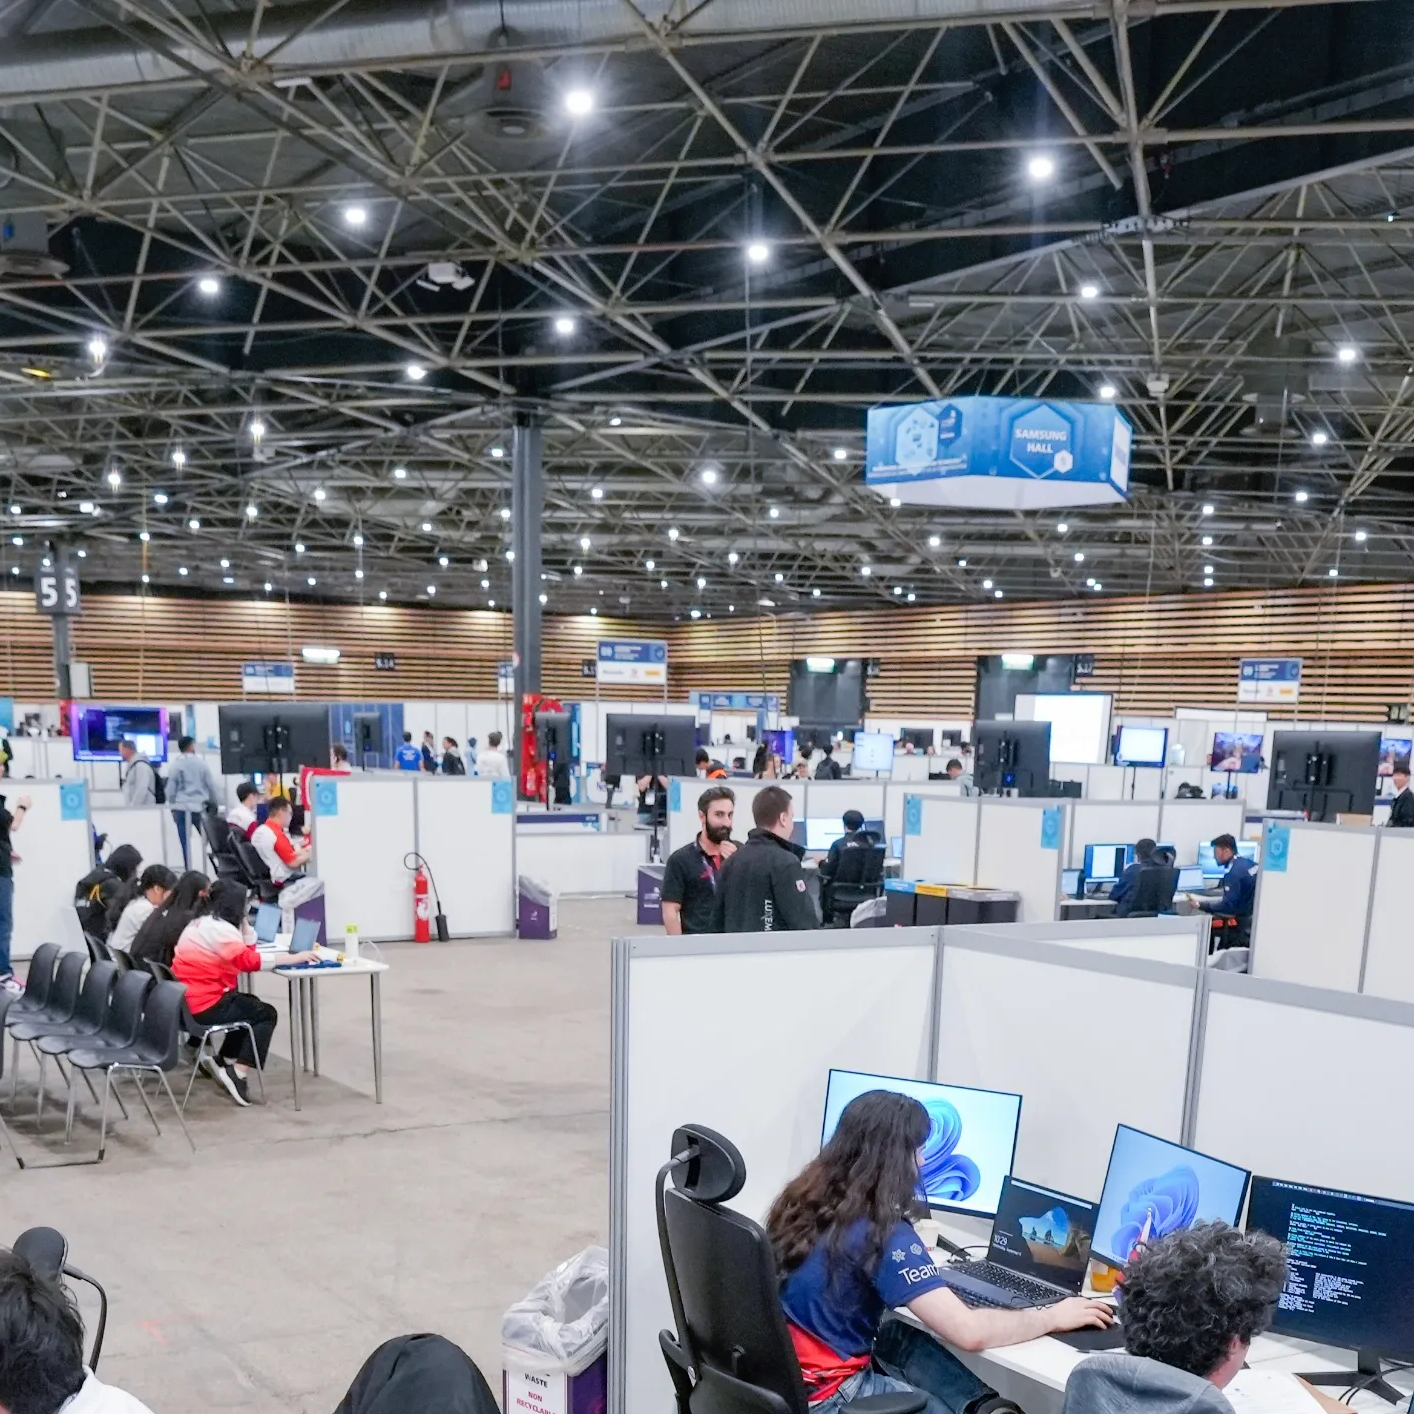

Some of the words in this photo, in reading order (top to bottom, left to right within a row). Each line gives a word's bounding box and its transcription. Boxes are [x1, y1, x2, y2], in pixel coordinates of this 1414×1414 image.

[1015, 429, 1067, 441] SAMSUNG
[1027, 442, 1053, 453] HALL
[41, 577, 58, 607] 5
[65, 578, 77, 608] 5
[898, 1264, 940, 1285] Team
[525, 1373, 548, 1388] WASTE
[528, 1391, 543, 1402] NON
